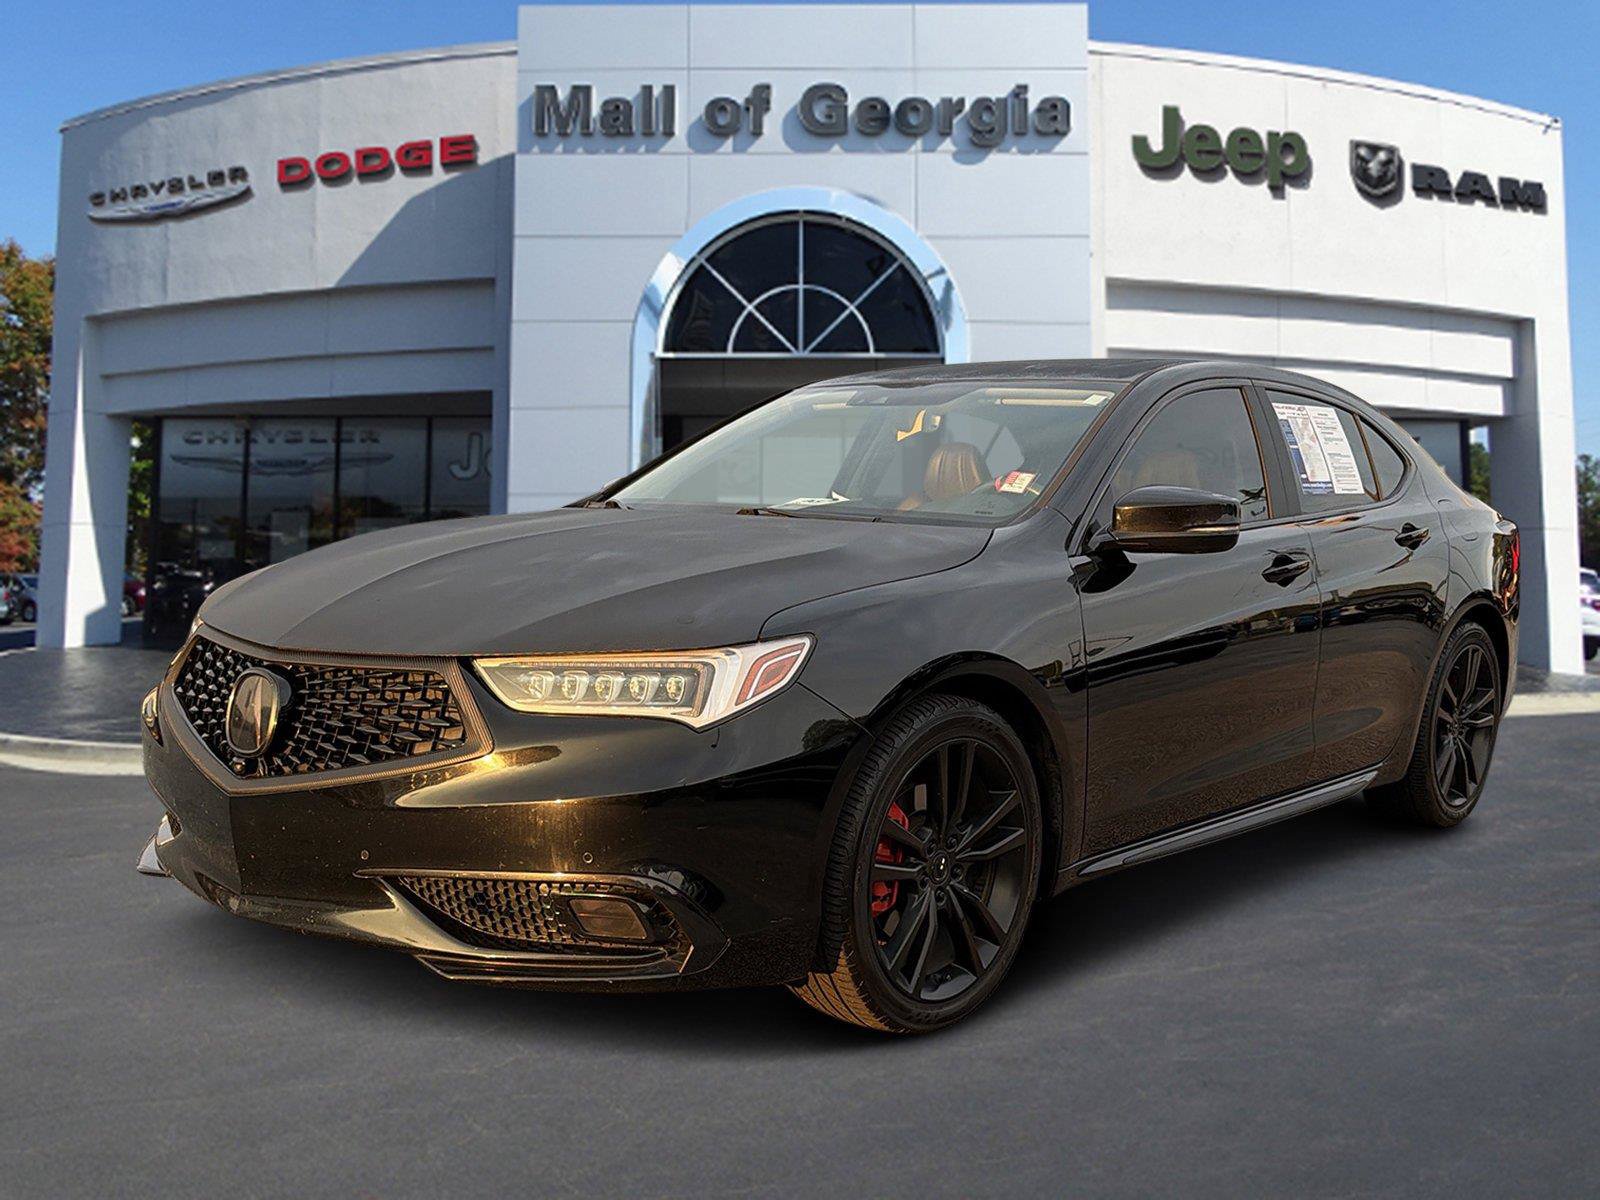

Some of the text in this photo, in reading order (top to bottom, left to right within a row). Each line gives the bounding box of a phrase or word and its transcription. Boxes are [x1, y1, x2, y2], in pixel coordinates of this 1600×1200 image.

[533, 83, 1073, 148] Mall of Georgia
[277, 134, 477, 186] DODGE
[1131, 105, 1307, 192] Jeep
[90, 166, 248, 206] CHRYSLER
[1411, 163, 1548, 213] RAM
[183, 429, 381, 444] CHRYSLER
